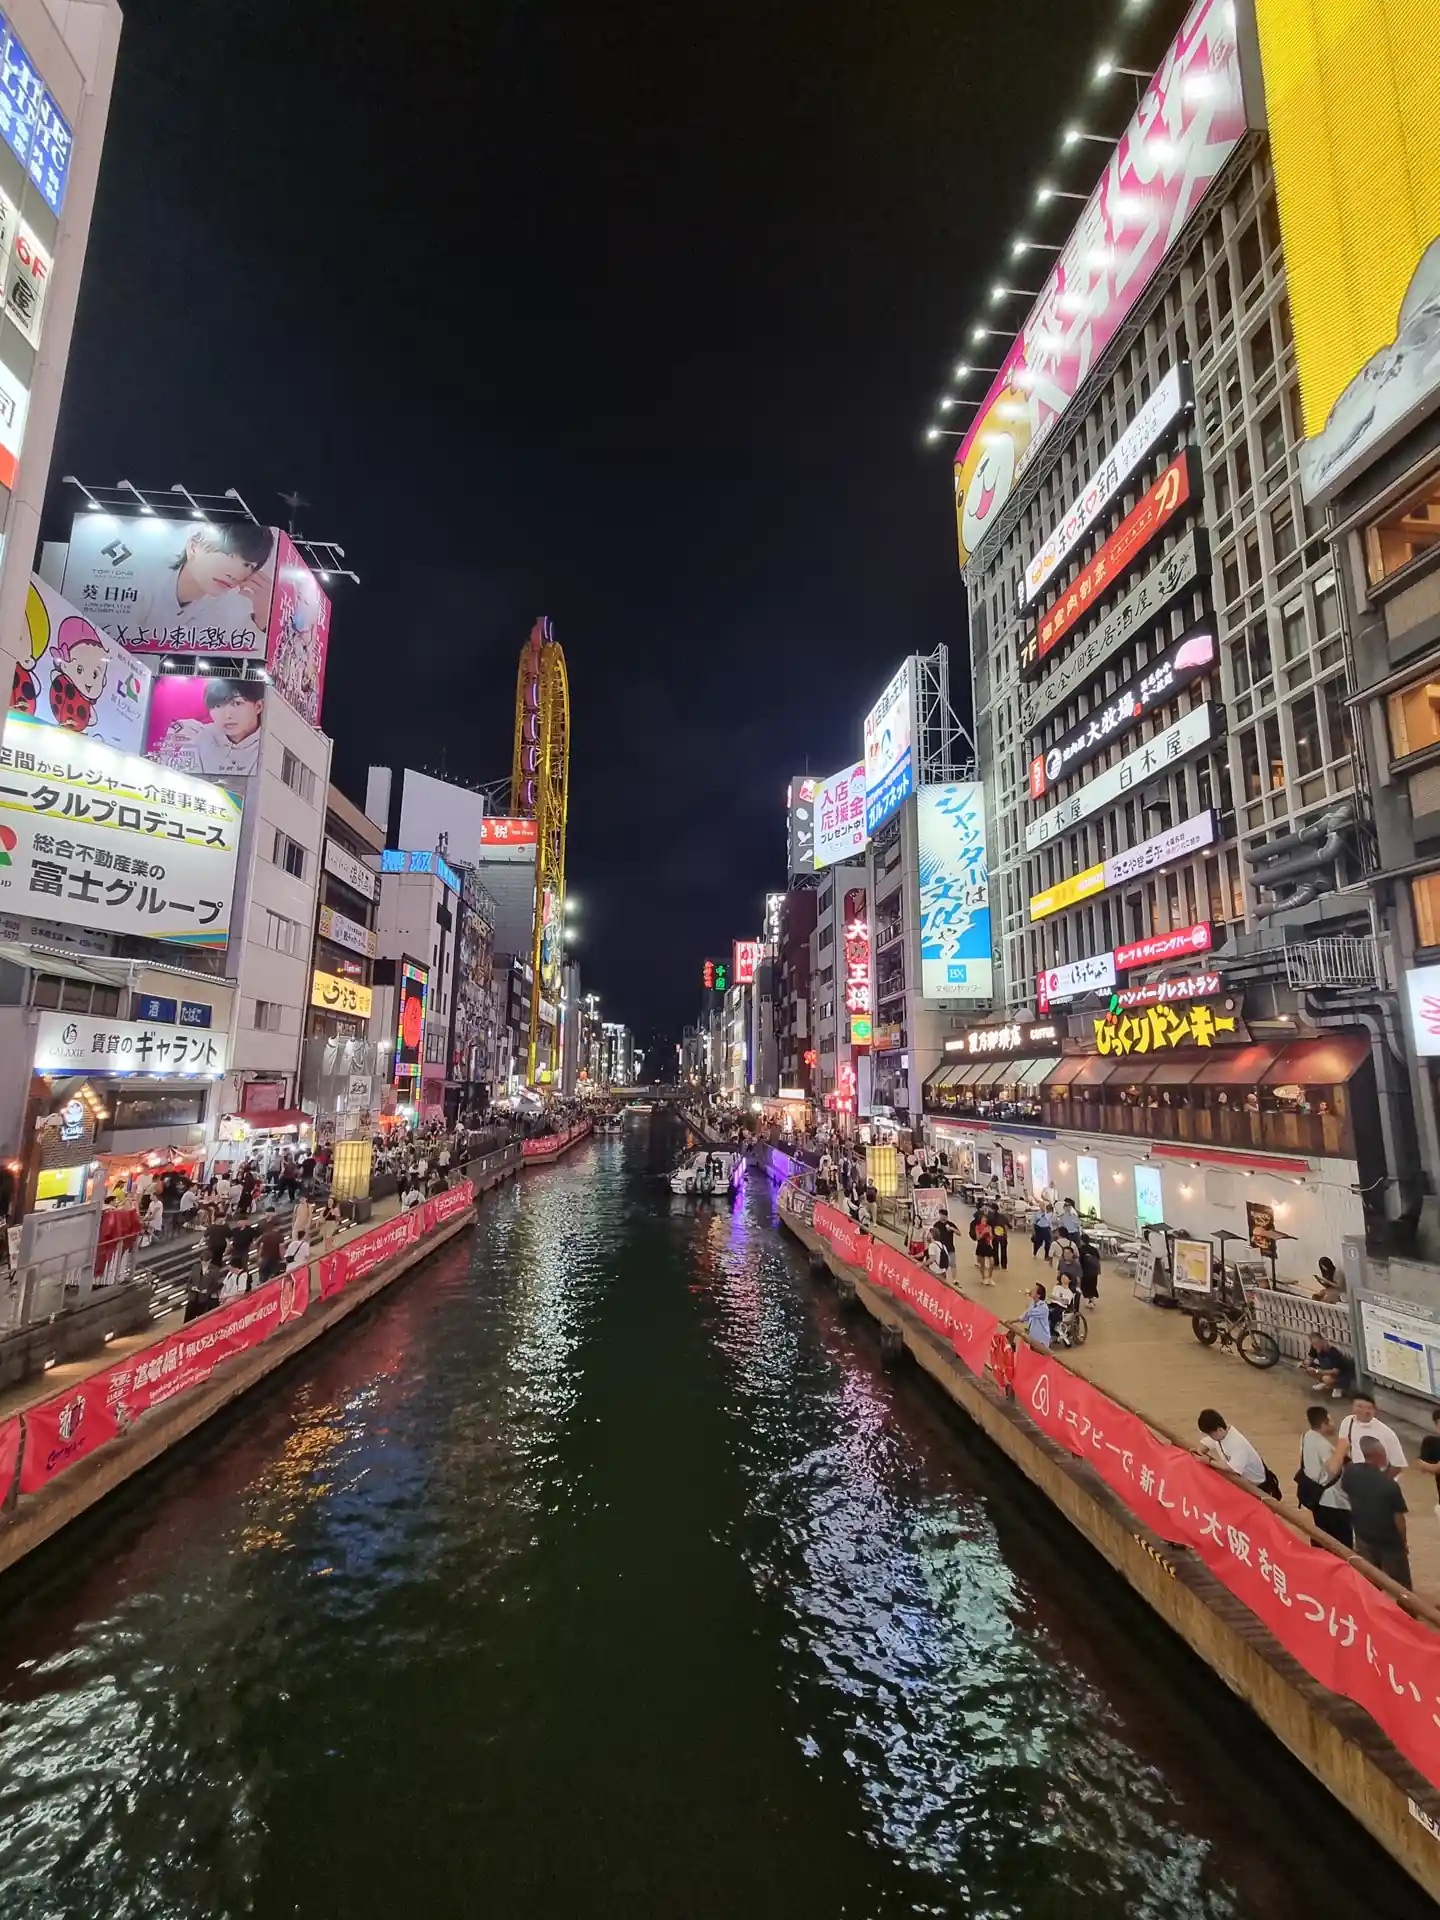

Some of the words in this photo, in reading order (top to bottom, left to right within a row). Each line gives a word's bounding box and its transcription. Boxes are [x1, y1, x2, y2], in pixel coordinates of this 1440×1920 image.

[1155, 467, 1180, 521] 刀
[83, 584, 99, 600] 葵
[105, 586, 138, 602] 日向
[1020, 635, 1037, 669] 7F
[1045, 589, 1153, 705] 完全個室居酒屋
[1086, 690, 1135, 741] 大牧場
[1119, 728, 1182, 790] 白木屋
[820, 796, 864, 831] 応援金
[821, 778, 849, 810] 入店
[868, 773, 910, 829] ガルフネット
[1038, 796, 1085, 841] 白木屋
[32, 832, 166, 881] 総合不動産業の
[933, 787, 987, 907] シャッターは
[28, 858, 225, 925] 富士グループ
[949, 968, 966, 980] BX
[1039, 978, 1047, 1008] 2F
[1117, 976, 1220, 1005] ハンバーグレストラン
[181, 1006, 203, 1023] たばこ
[1093, 1005, 1235, 1056] びっくりドンキー
[91, 1031, 218, 1067] 賃貸のギャラント
